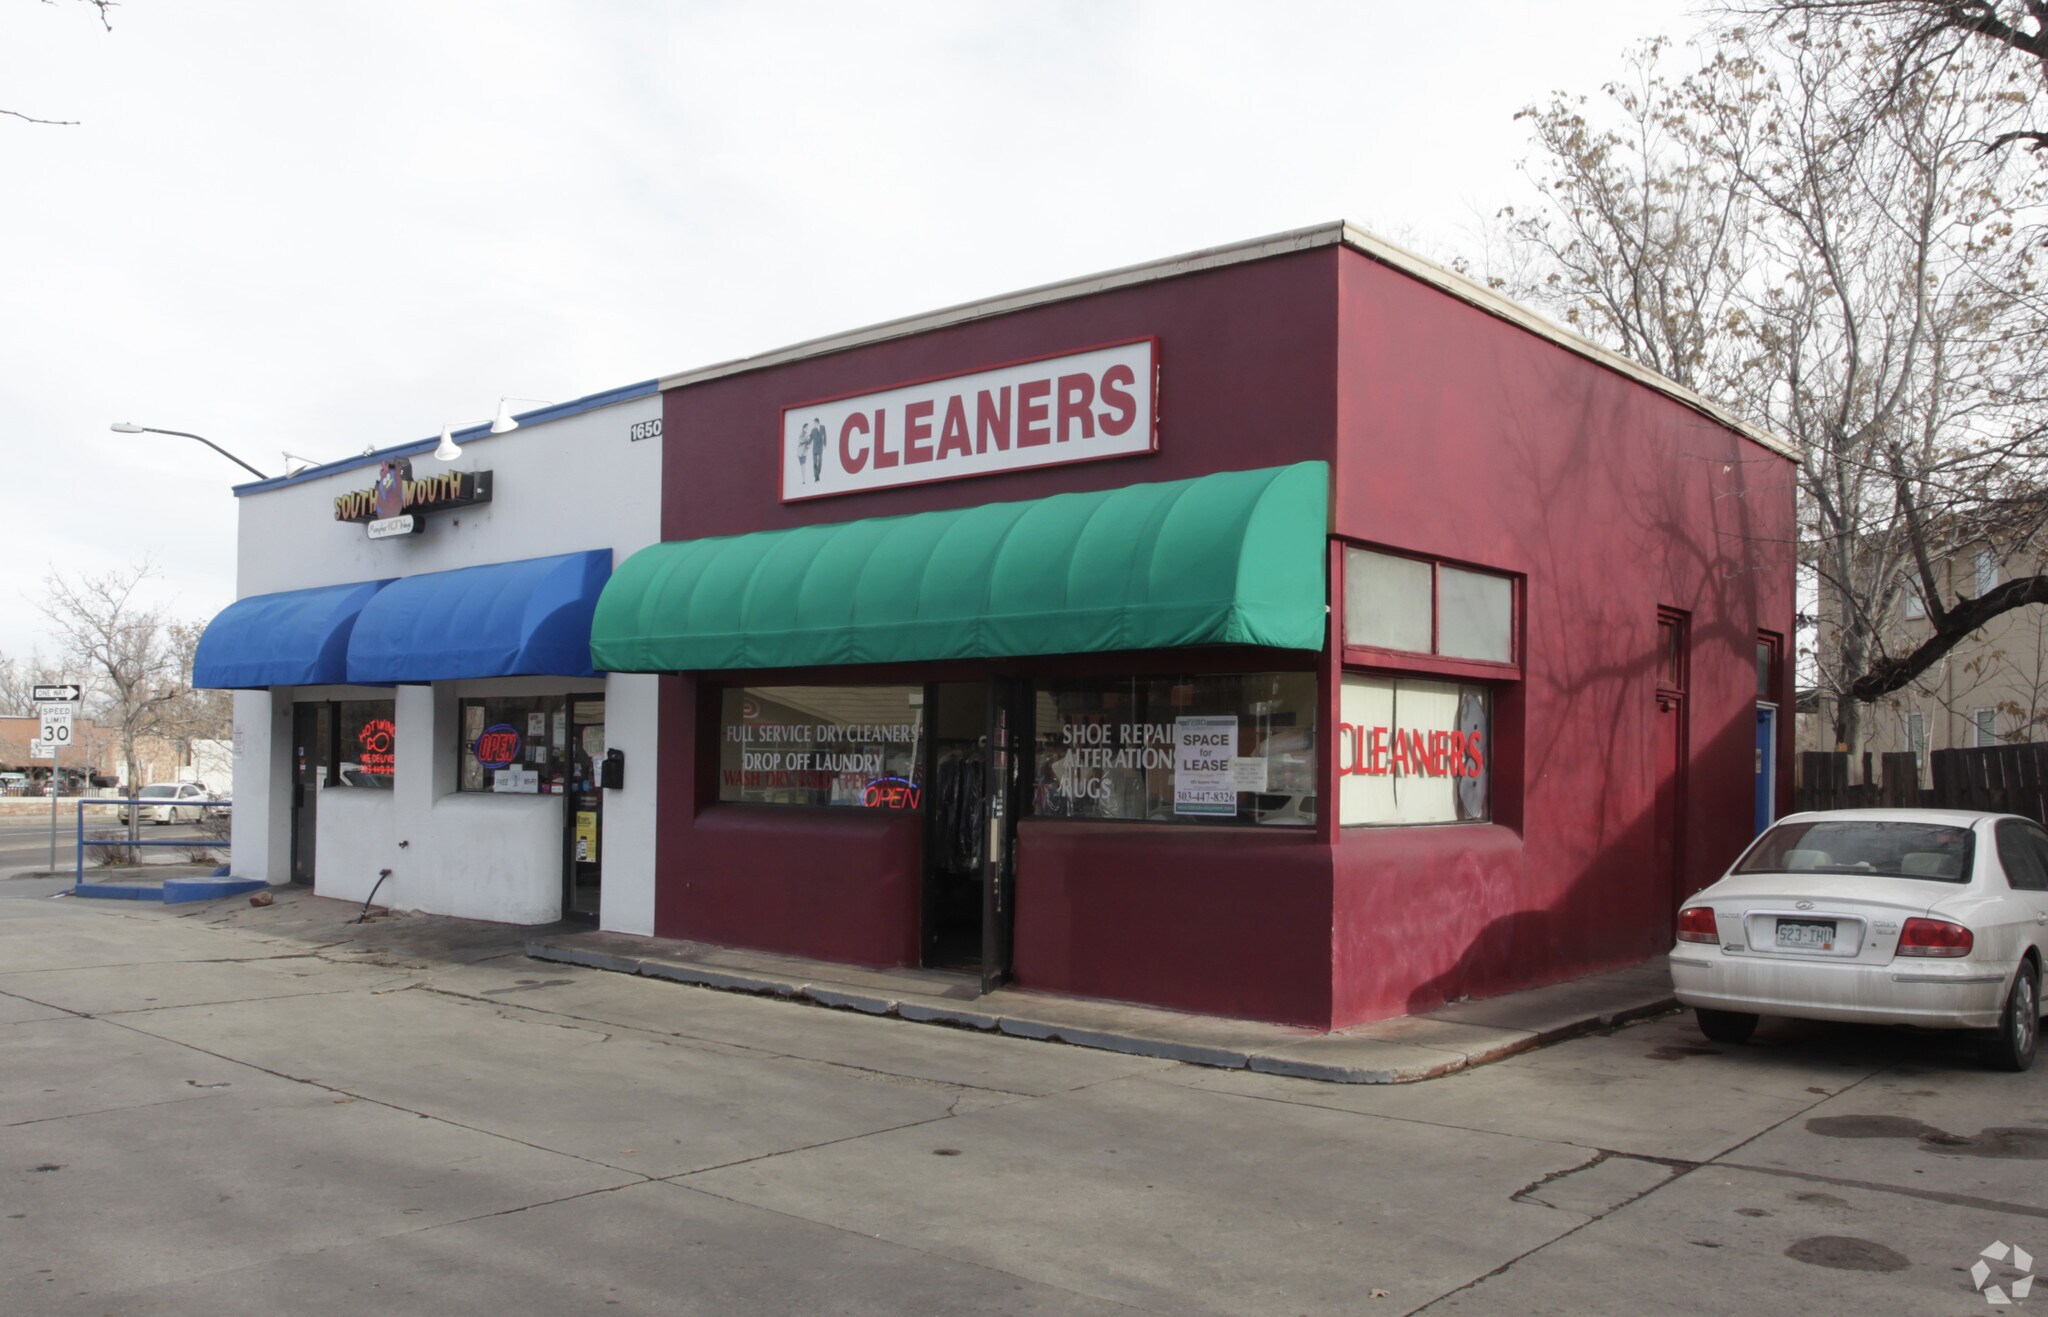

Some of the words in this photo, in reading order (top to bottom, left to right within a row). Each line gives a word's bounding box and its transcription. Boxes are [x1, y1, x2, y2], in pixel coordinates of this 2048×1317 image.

[838, 363, 1137, 475] CLEANERS
[631, 419, 662, 441] 1650
[334, 488, 378, 521] SOUTH
[402, 470, 462, 508] MOUTH
[43, 707, 70, 715] SPEED
[45, 716, 67, 724] LIMIT
[43, 725, 69, 741] 30
[358, 720, 376, 742] HOT
[726, 724, 754, 742] FULL
[758, 724, 811, 742] SERVICE
[1062, 723, 1112, 744] SHOE
[1183, 734, 1230, 746] SPACE
[478, 733, 518, 761] OPEN
[1199, 748, 1212, 757] for
[744, 752, 781, 770] DROP
[785, 752, 811, 770] OFF
[816, 753, 883, 772] LAUNDRY
[1183, 759, 1229, 771] LEASE
[723, 769, 761, 786] WASH
[765, 770, 792, 787] DRY
[863, 785, 921, 809] OPEN
[1176, 791, 1235, 802] 303-447-8326
